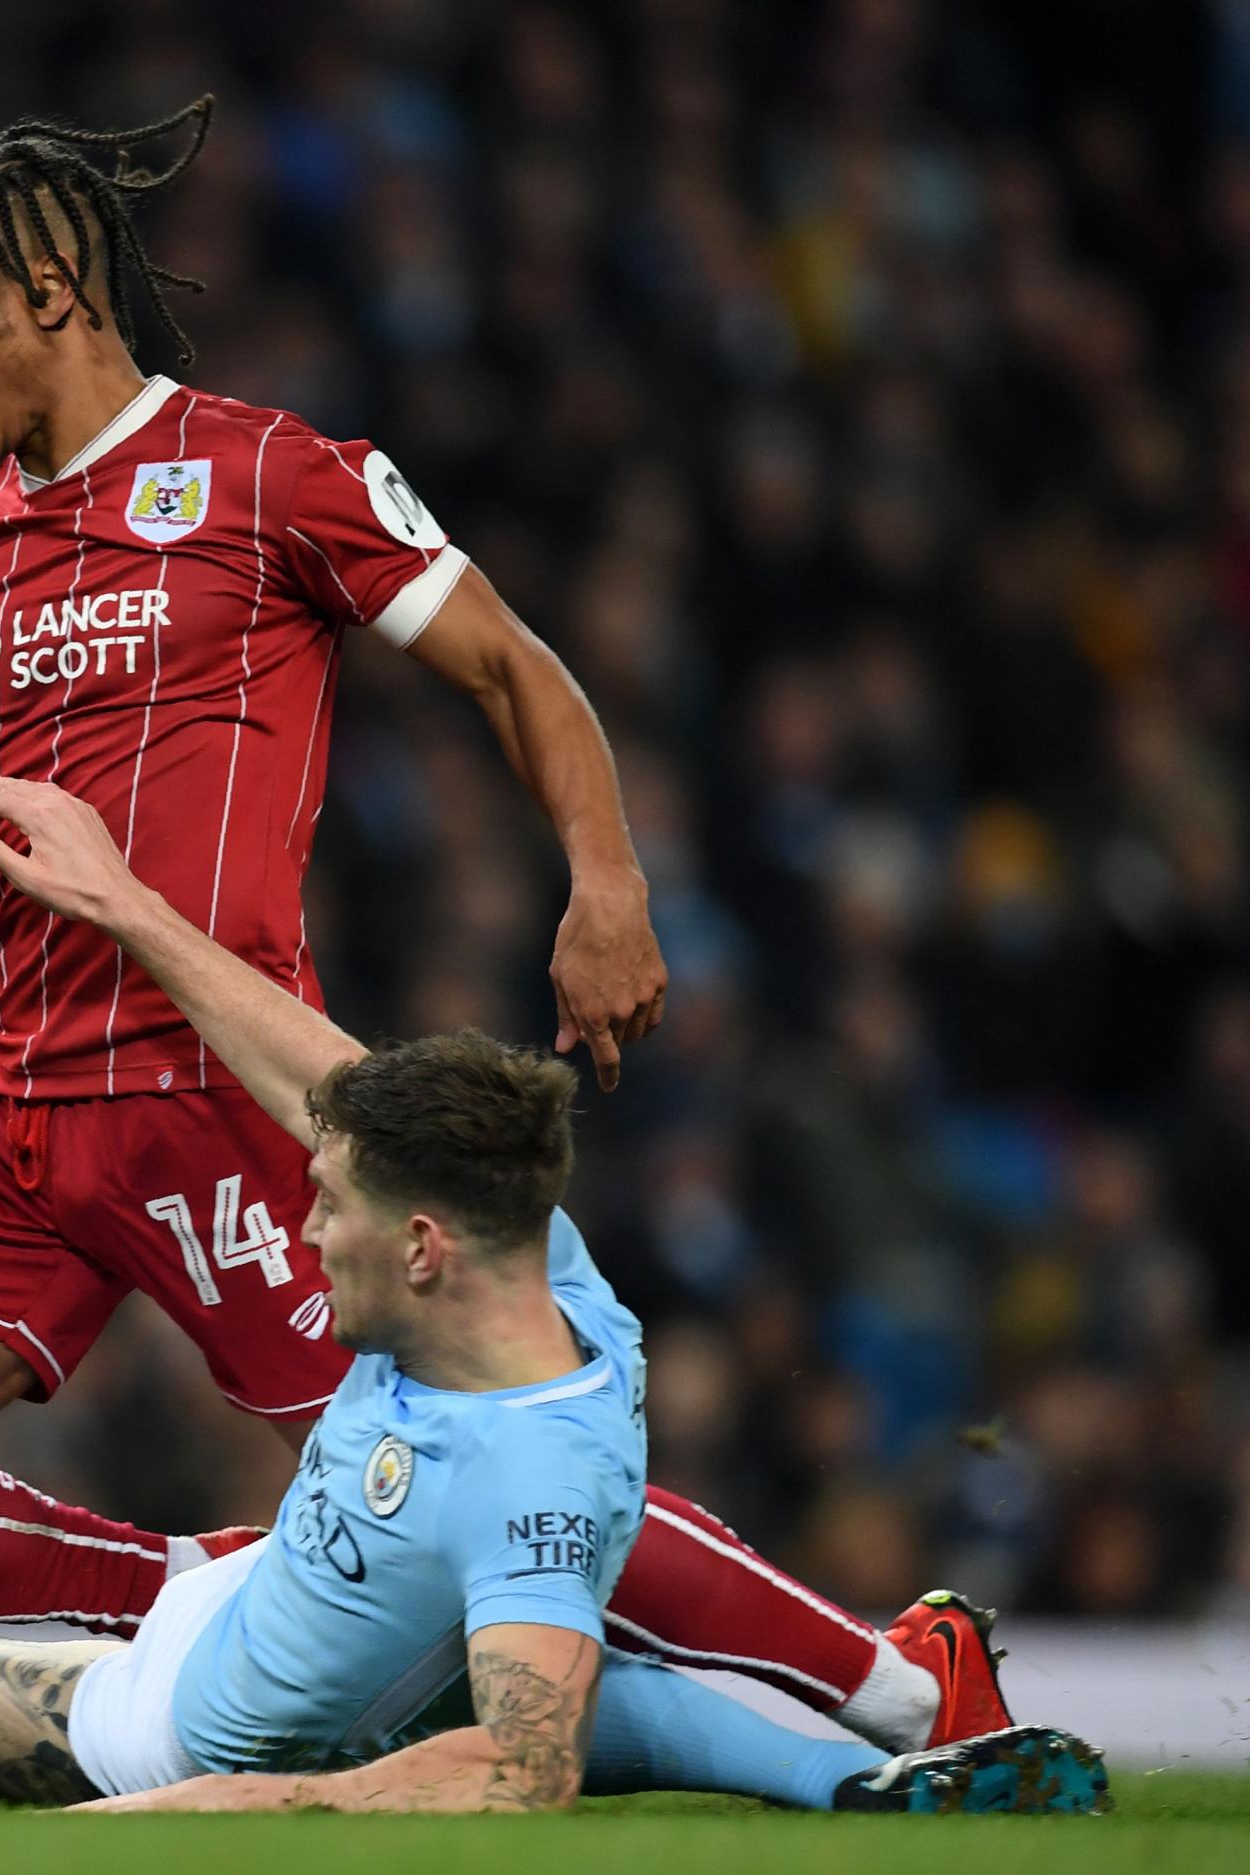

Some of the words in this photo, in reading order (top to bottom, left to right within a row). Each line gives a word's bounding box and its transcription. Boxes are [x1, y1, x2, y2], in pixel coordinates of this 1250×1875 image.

[13, 590, 171, 646] LANCER
[10, 635, 145, 689] SCOTT
[145, 1174, 294, 1306] 14
